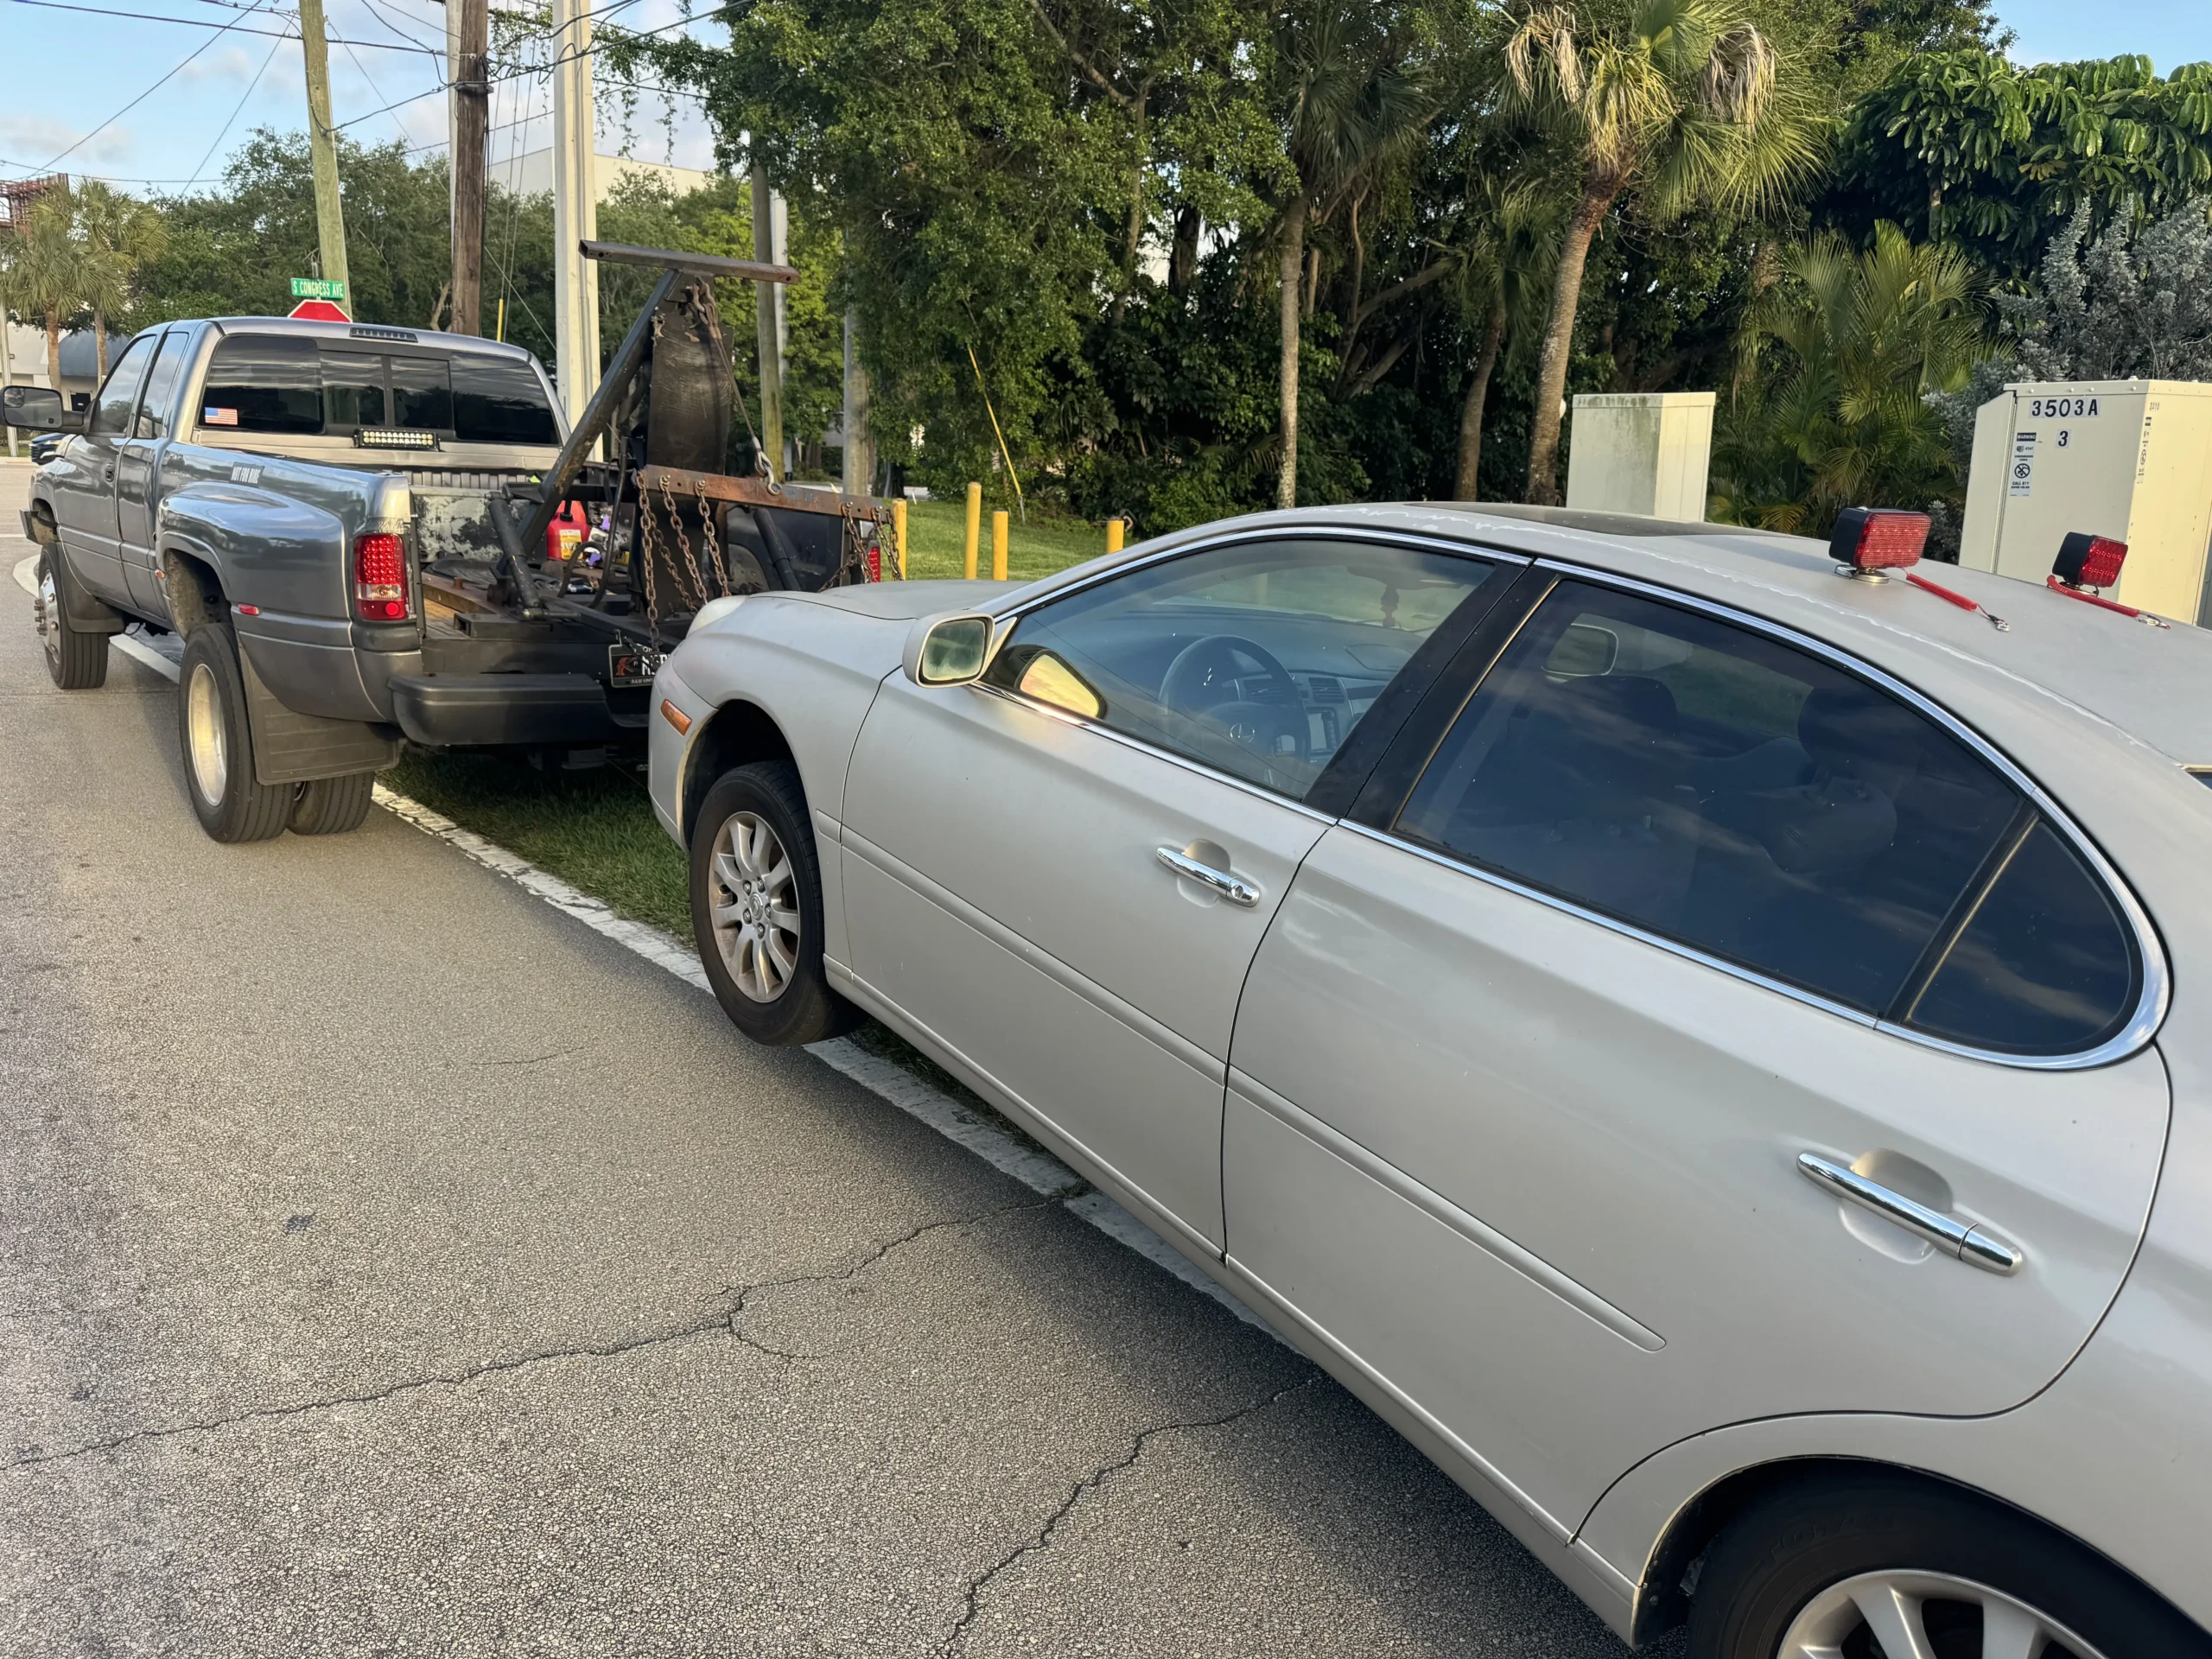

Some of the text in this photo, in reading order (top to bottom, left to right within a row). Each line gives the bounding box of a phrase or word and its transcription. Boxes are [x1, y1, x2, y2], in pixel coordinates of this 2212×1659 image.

[293, 279, 344, 297] S CONGRESS AVE
[2031, 398, 2098, 417] 3503A
[2057, 430, 2069, 447] 3
[231, 466, 261, 484] NOT FOR HIRE
